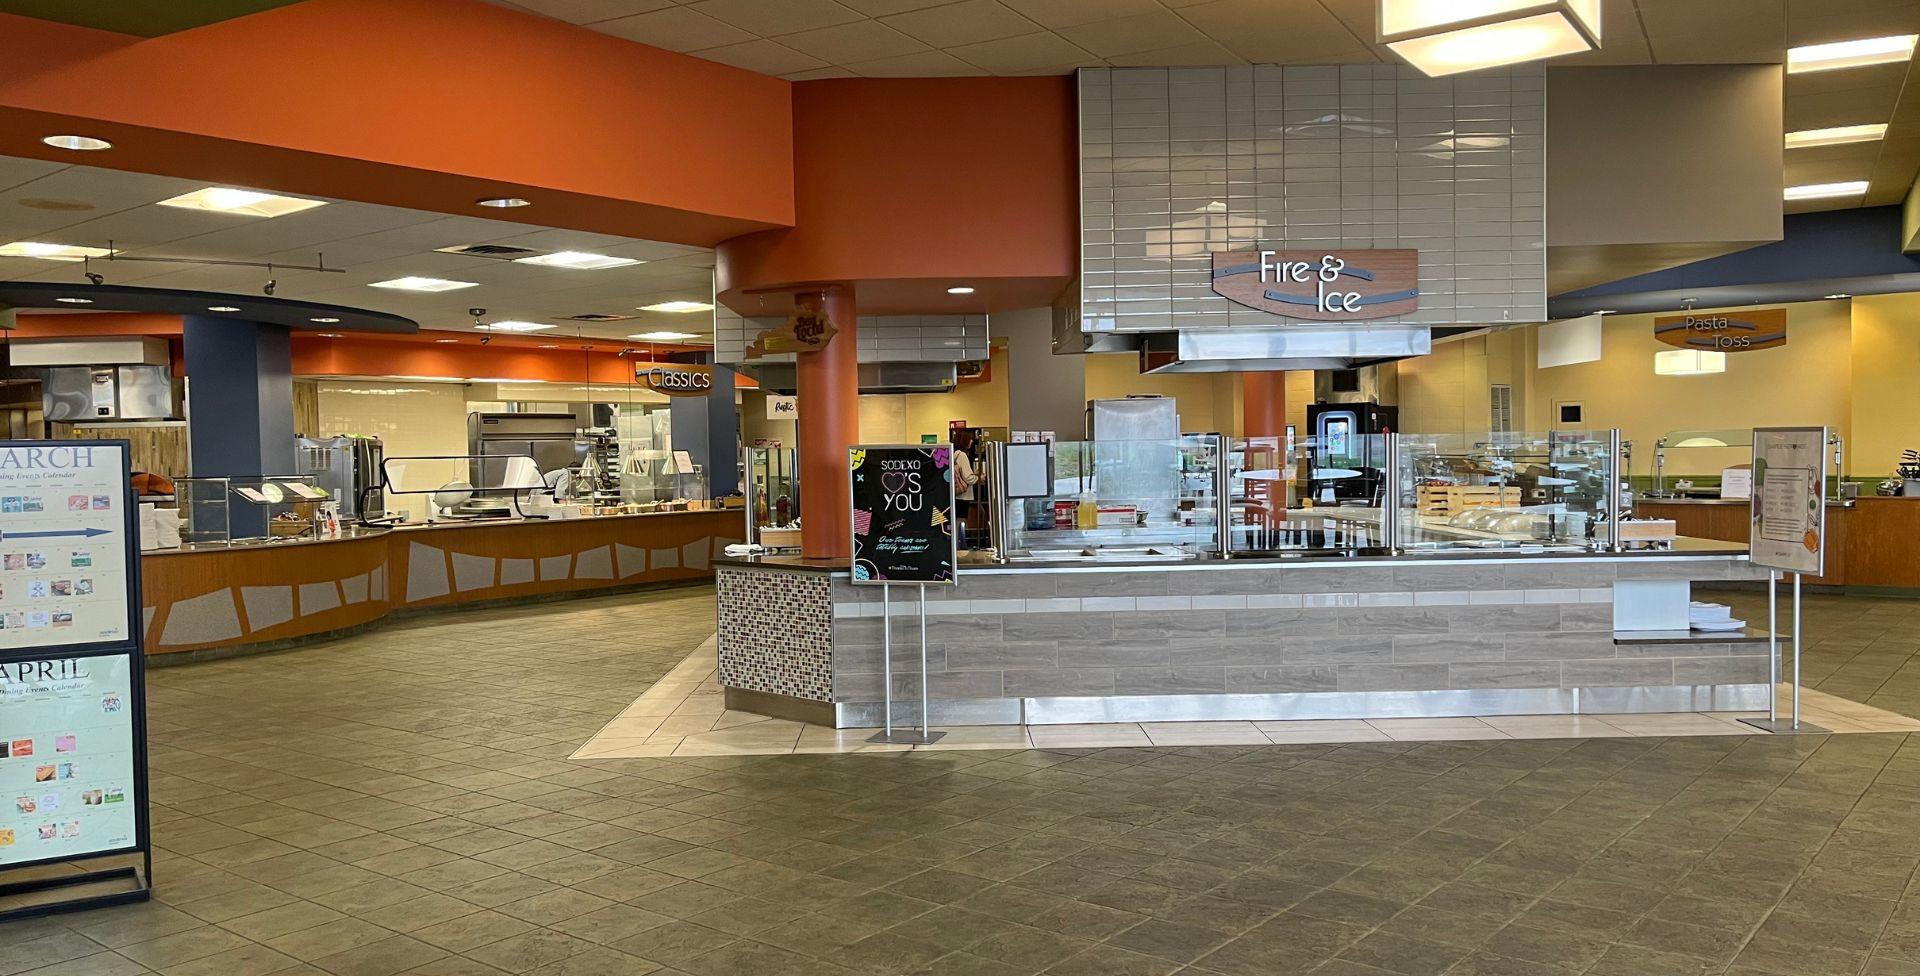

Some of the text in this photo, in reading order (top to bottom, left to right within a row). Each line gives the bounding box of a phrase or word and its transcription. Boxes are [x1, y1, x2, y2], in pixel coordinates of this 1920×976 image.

[1260, 250, 1345, 283] Fire &
[1317, 281, 1362, 312] Ice
[1686, 315, 1728, 331] Pasta
[1712, 334, 1750, 348] Toss
[649, 366, 711, 388] Classics
[881, 460, 921, 470] SODEXO
[43, 471, 76, 479] Calendar
[883, 493, 923, 511] YOU
[0, 658, 91, 684] APRIL
[51, 683, 84, 691] Calendar
